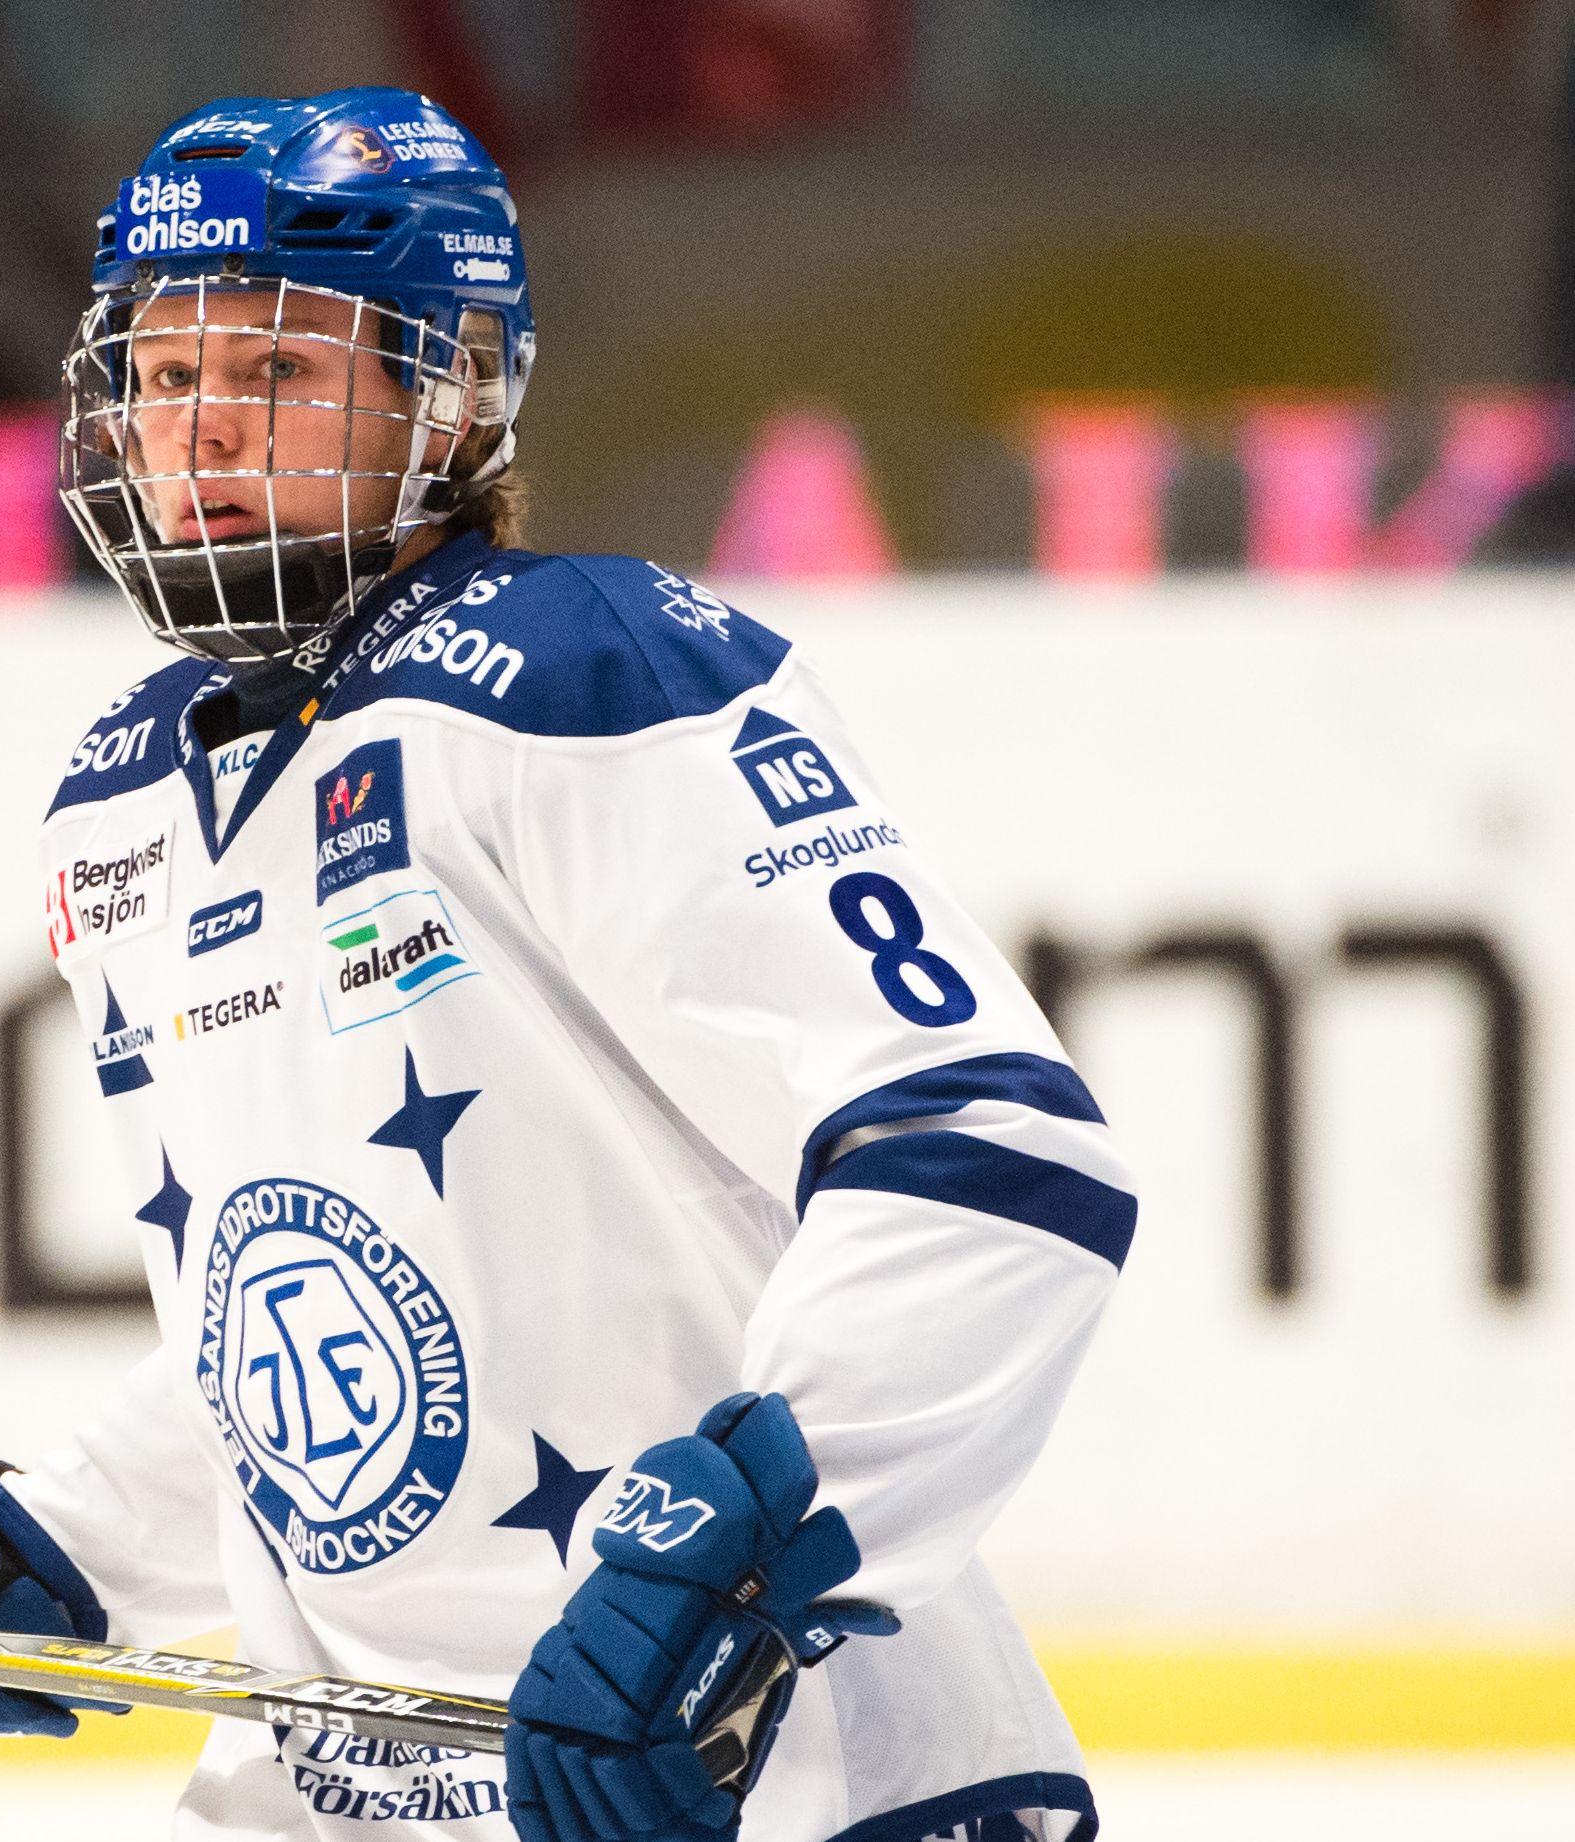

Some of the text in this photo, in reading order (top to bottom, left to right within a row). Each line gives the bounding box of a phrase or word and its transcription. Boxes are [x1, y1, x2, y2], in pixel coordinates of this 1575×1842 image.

[393, 139, 468, 162] DÖRREN
[130, 174, 202, 215] clas
[126, 213, 250, 255] ohlson
[443, 232, 514, 257] ELMAB.SE
[755, 750, 835, 809] NS
[188, 901, 259, 947] CCM
[828, 871, 977, 1028] 8
[218, 1183, 463, 1440] IDROTTSFÖRENING
[199, 1241, 263, 1496] LEKSANDS
[284, 1467, 446, 1571] ISHOCKEY
[263, 1701, 357, 1735] CCM
[290, 1681, 434, 1717] CCM
